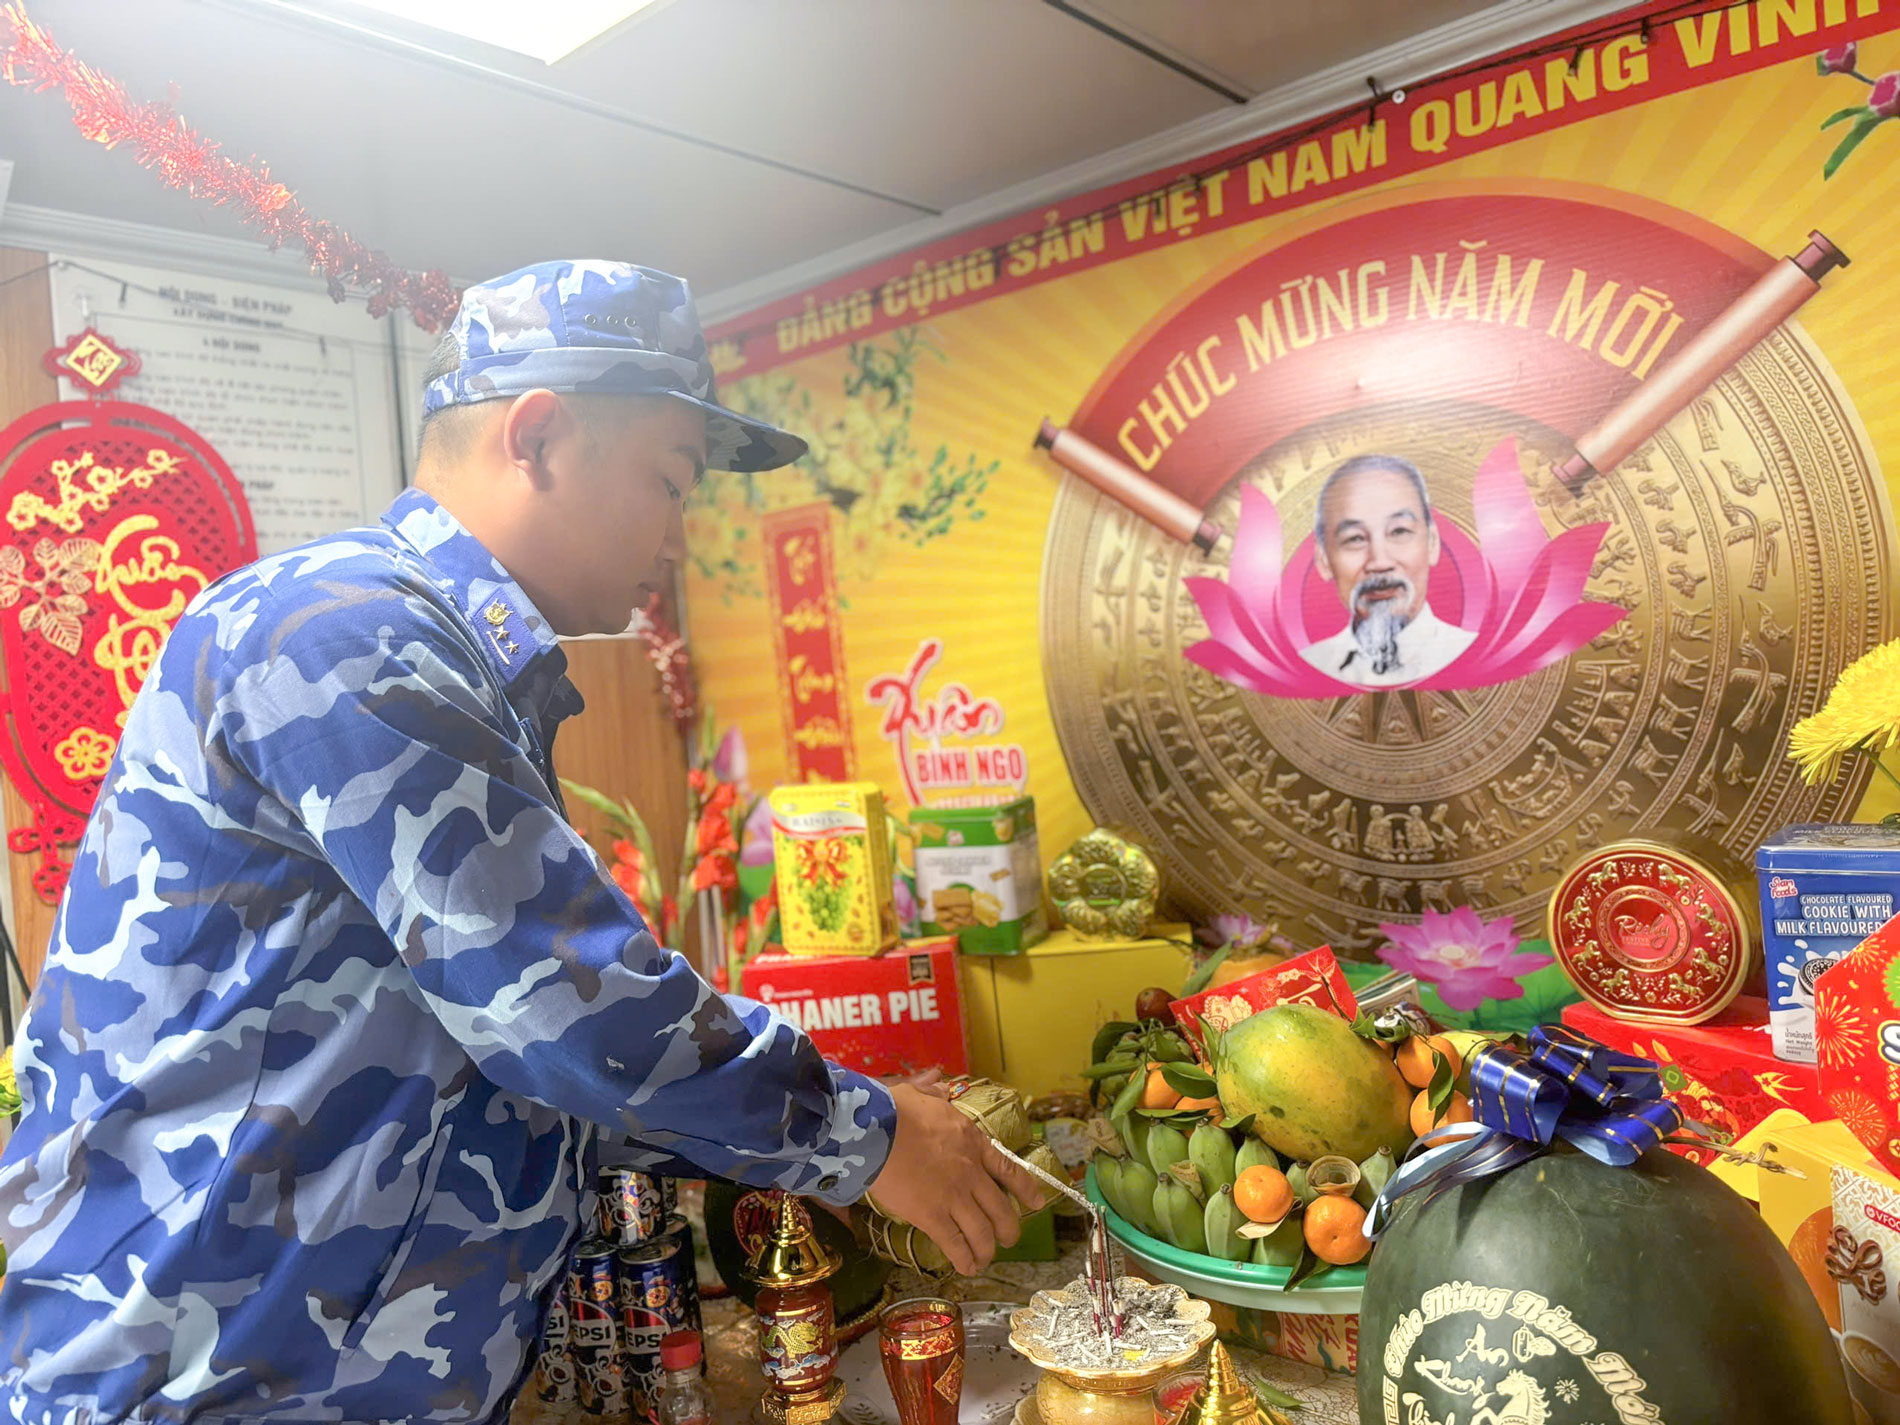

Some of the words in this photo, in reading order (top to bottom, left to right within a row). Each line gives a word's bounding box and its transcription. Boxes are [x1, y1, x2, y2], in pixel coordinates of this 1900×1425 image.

[881, 247, 998, 317] CỘNG
[1008, 211, 1106, 276] SẢN
[1119, 170, 1230, 243] VIỆT
[1248, 120, 1387, 206] NAM
[1410, 37, 1650, 153] QUANG
[1117, 337, 1237, 473] CHÚC
[1235, 260, 1389, 373] MỪNG
[1406, 239, 1546, 328] NĂM
[1546, 267, 1684, 381] MỚI
[1801, 895, 1845, 905] CHOCOLATE
[1847, 894, 1892, 904] FLAVOURED
[1803, 905, 1849, 919] COOKIE
[1855, 905, 1891, 919] WITH
[1776, 921, 1806, 935] MILK
[888, 988, 940, 1025] PIE
